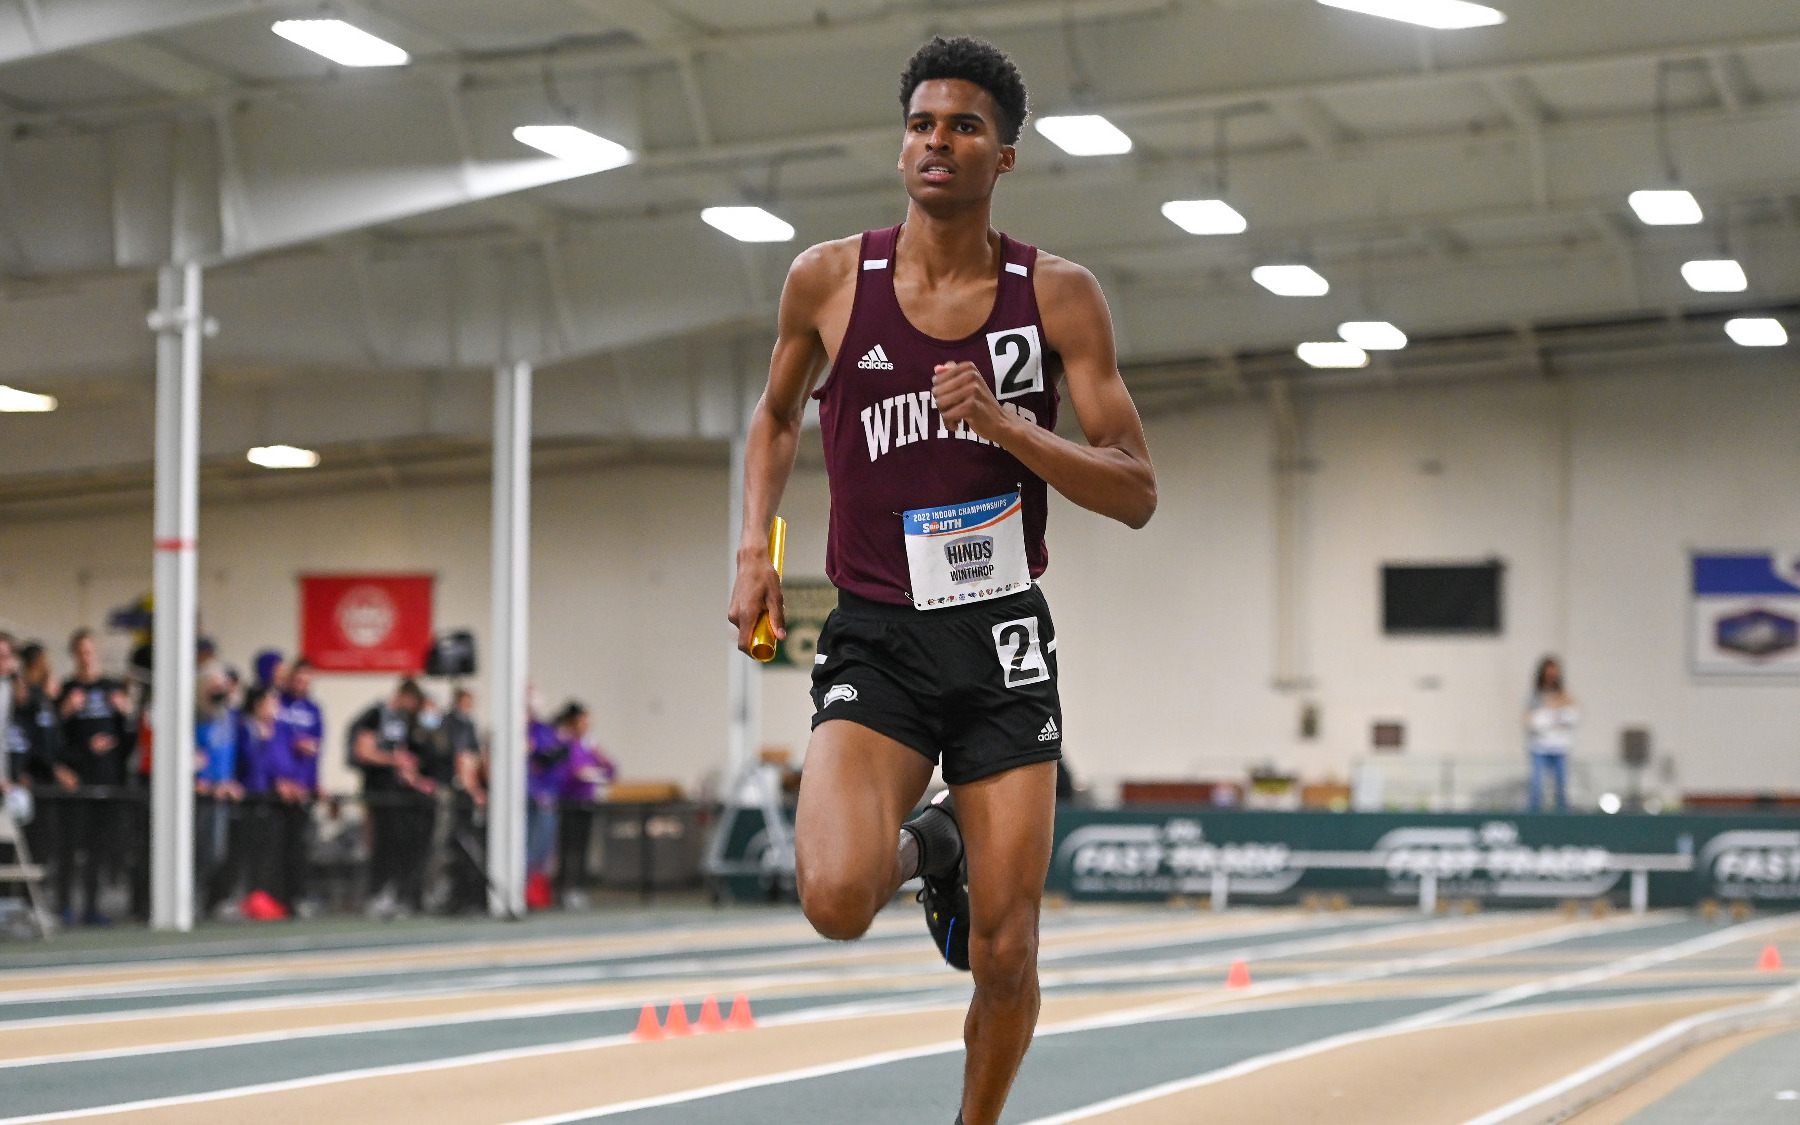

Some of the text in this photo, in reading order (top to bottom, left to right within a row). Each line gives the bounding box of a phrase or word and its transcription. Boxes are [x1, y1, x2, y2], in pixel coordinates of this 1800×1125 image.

[857, 359, 894, 370] adidas
[995, 333, 1034, 394] 2
[913, 499, 1007, 522] 2022 INDOOR CHAMPIONSHIPS
[947, 540, 992, 565] HINDS
[950, 564, 994, 581] WINTHROP
[1000, 623, 1040, 683] 2
[1037, 731, 1060, 741] adidas
